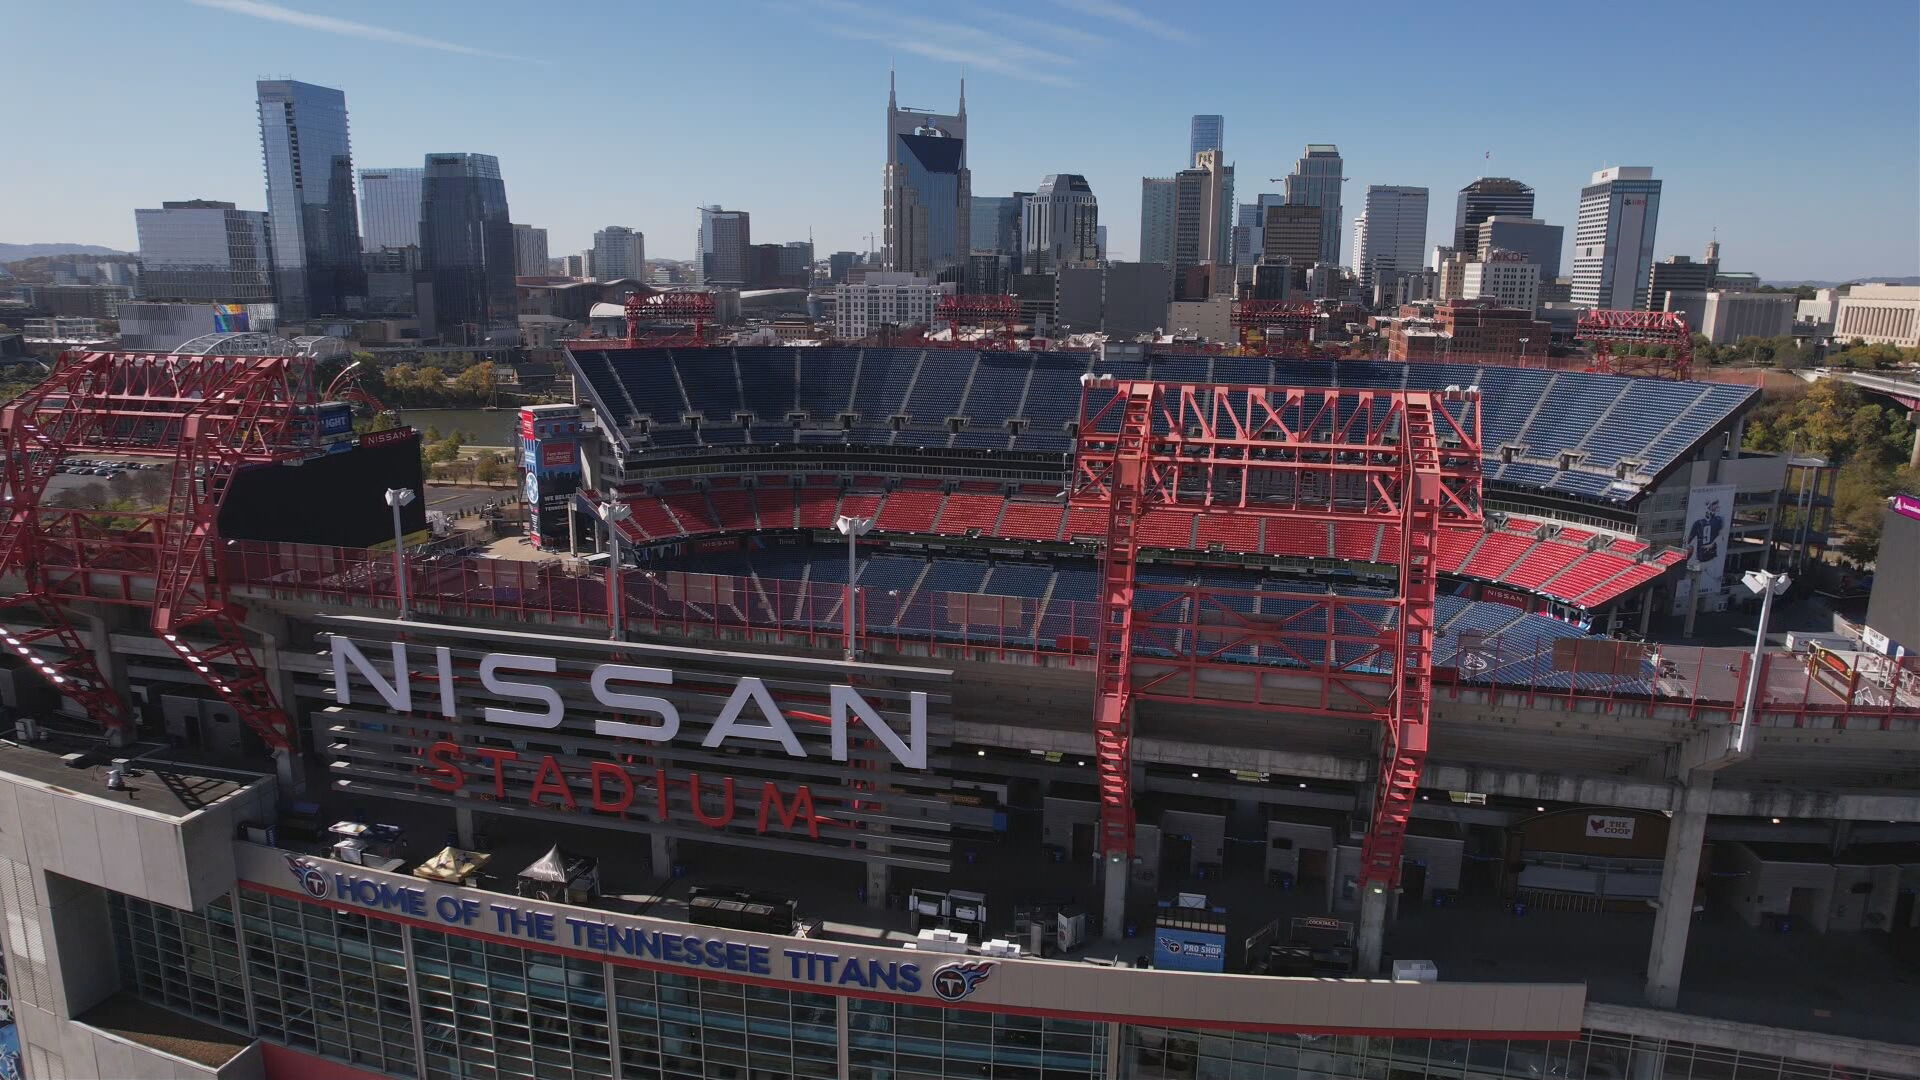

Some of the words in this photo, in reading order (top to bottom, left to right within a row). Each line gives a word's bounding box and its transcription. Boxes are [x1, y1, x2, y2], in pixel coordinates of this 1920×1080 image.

[368, 431, 406, 445] NISSAN
[1487, 589, 1523, 602] NISSAN
[331, 635, 927, 770] NISSAN
[427, 741, 820, 840] STADIUM
[334, 872, 428, 917] HOME
[435, 895, 481, 926] OF
[491, 903, 556, 942] THE
[566, 917, 772, 975] TENNESSEE
[784, 949, 923, 993] TITANS
[1184, 944, 1199, 953] PRO
[1200, 946, 1222, 956] SHOP
